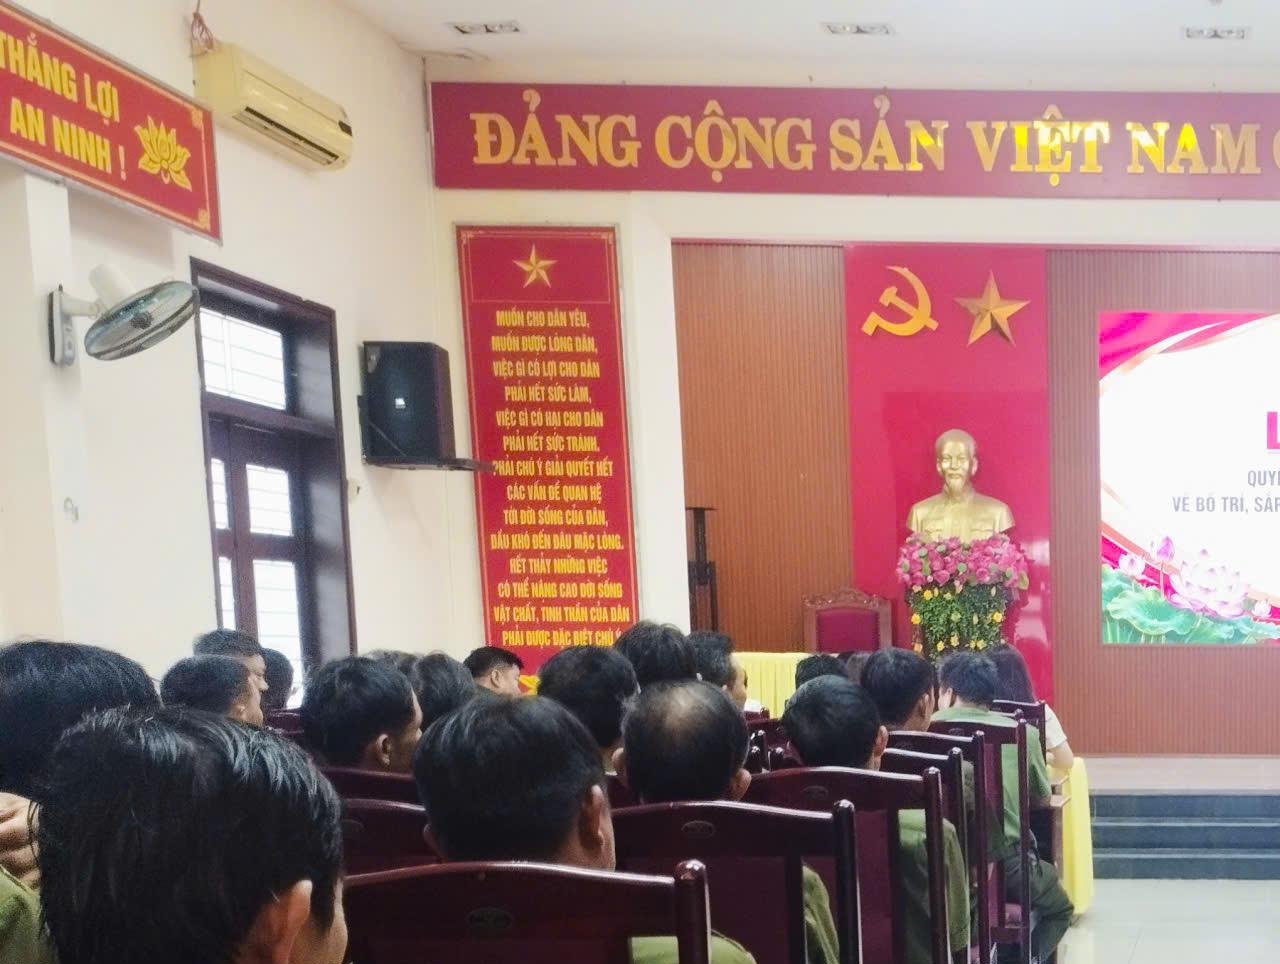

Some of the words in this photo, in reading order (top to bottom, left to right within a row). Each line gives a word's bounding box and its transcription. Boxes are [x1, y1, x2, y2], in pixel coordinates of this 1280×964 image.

[83, 72, 120, 126] LỢI
[10, 97, 46, 146] AN
[52, 115, 112, 174] NINH
[470, 89, 641, 168] ĐẢNG
[655, 100, 814, 183] CỘNG
[829, 95, 949, 173] SẢN
[966, 105, 1110, 187] VIỆT
[1126, 121, 1260, 176] NAM
[496, 305, 524, 327] MUỐN
[526, 311, 545, 327] CHO
[547, 308, 567, 327] DÂN
[492, 330, 519, 351] MUỐN
[493, 358, 513, 380] VIỆC
[515, 358, 525, 377] GÌ
[527, 358, 540, 377] CÓ
[542, 362, 556, 380] LỢI
[559, 362, 578, 377] CHO
[580, 358, 600, 377] DÂN
[505, 381, 526, 401] PHẢI
[528, 380, 544, 401] HẾT
[547, 381, 566, 402] SỨC
[496, 408, 516, 429] VIỆC
[518, 408, 528, 426] GÌ
[530, 408, 543, 426] CÓ
[545, 411, 561, 430] HẠI
[562, 412, 582, 426] CHO
[583, 408, 604, 427] DÂN
[503, 430, 524, 451] PHẢI
[526, 430, 542, 451] HẾT
[546, 430, 564, 451] SỨC
[503, 505, 518, 524] TỚI
[538, 504, 563, 525] SỐNG
[510, 552, 525, 574] HẾT
[587, 555, 608, 577] VIỆC
[498, 579, 510, 597] CÓ
[513, 577, 529, 597] THỂ
[559, 583, 577, 598] CAO
[597, 577, 623, 598] SỐNG
[494, 604, 509, 625] VẬT
[541, 607, 562, 621] TINH
[610, 604, 630, 621] DÂN
